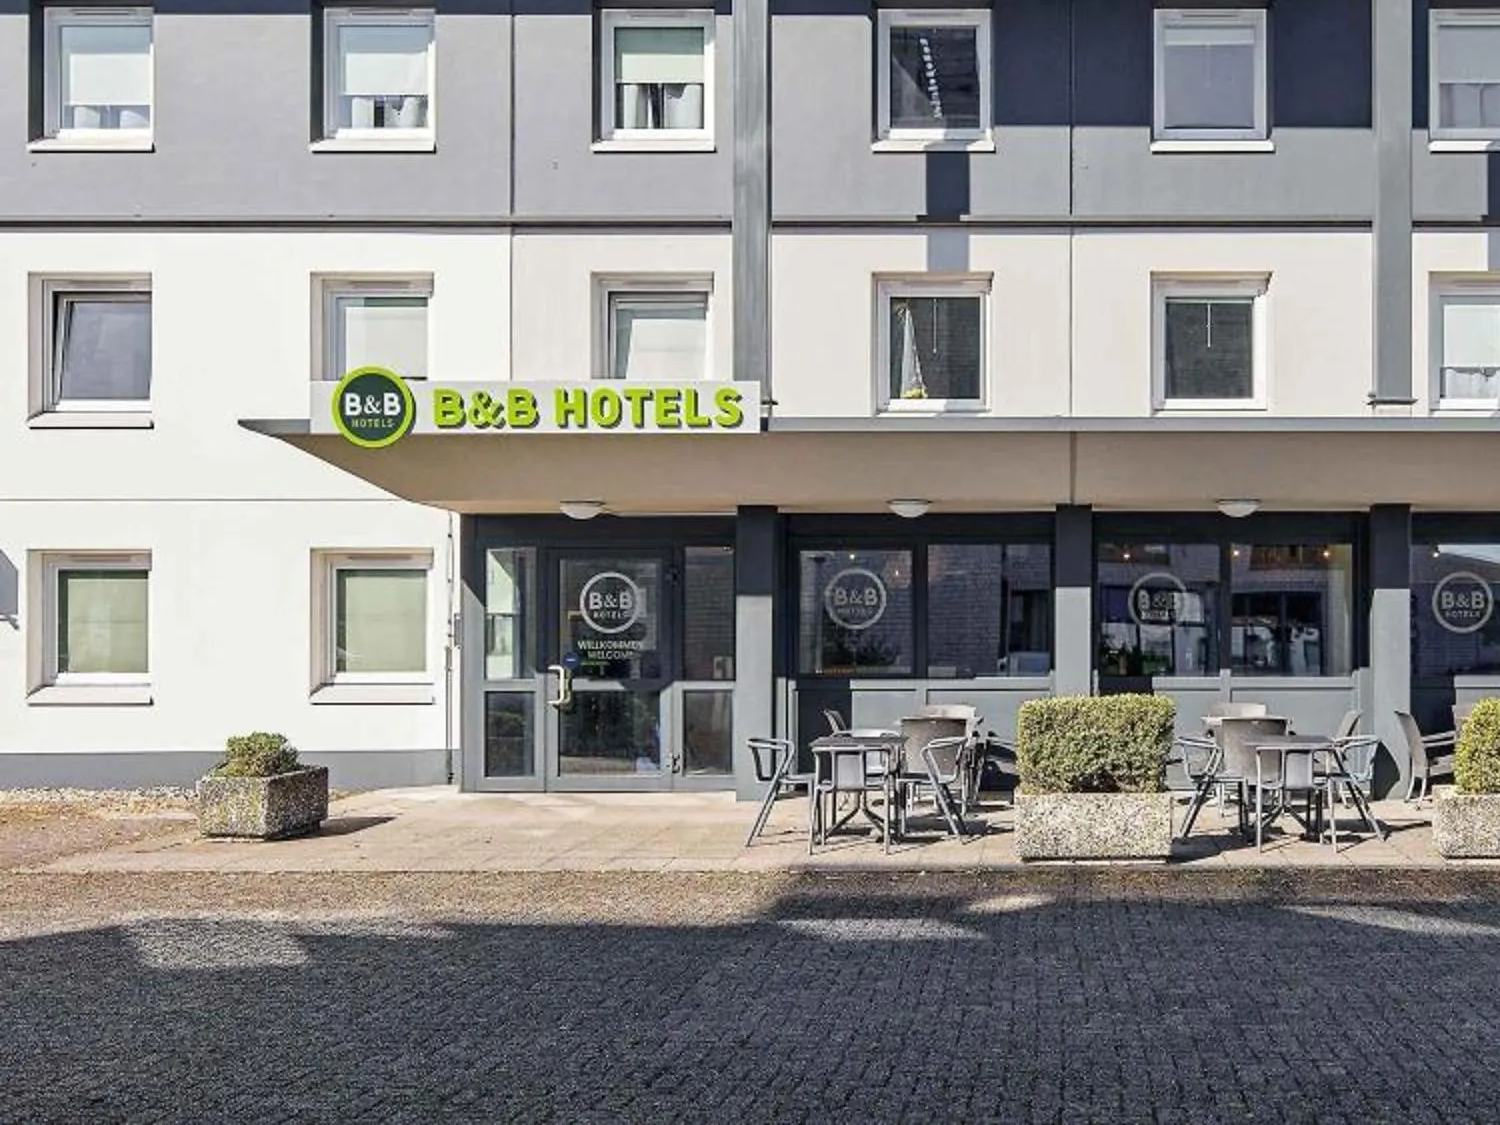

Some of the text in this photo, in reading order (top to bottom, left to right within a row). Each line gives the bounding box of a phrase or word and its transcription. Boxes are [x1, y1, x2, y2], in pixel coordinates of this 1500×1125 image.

[345, 392, 401, 416] B&B
[433, 387, 746, 430] B&B HOTELS
[351, 418, 394, 428] HOTELS
[589, 591, 633, 610] B&B
[835, 587, 878, 606] B&B
[1441, 590, 1486, 610] B&B
